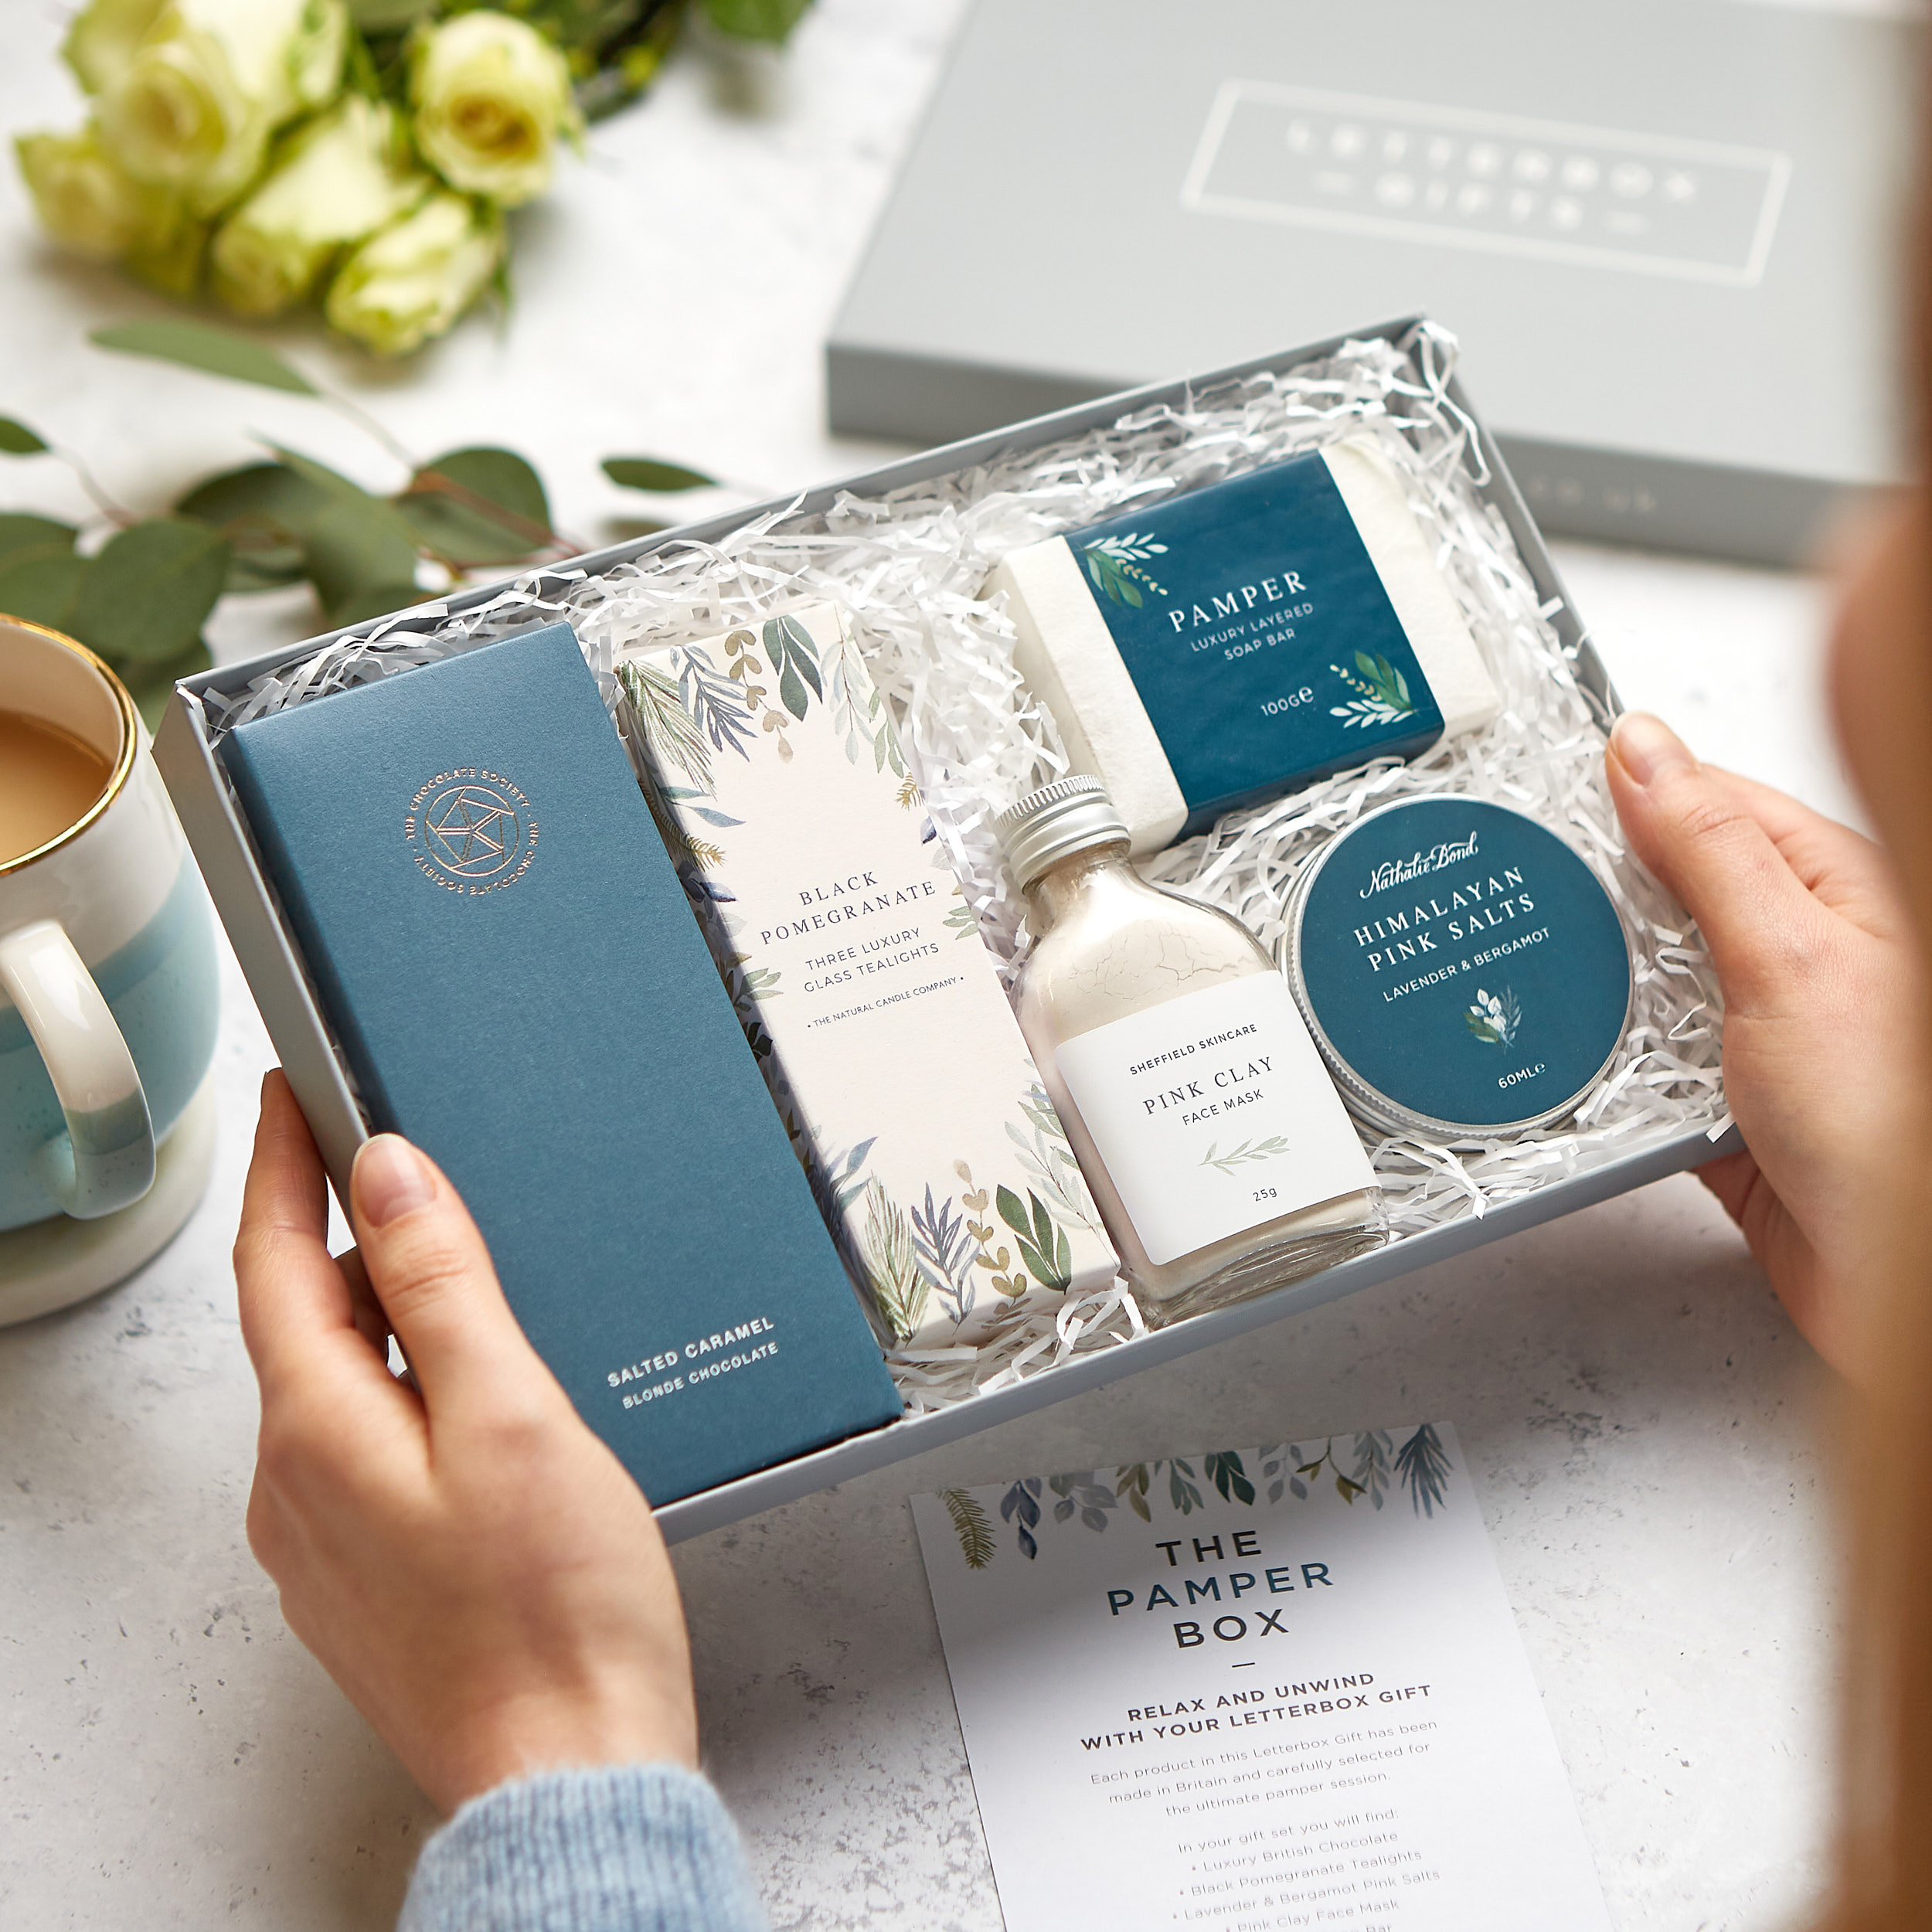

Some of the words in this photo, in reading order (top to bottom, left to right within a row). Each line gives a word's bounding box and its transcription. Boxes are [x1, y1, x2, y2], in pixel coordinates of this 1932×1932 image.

[1168, 570, 1307, 633] PAMPER
[1190, 626, 1245, 652] LUXURY
[1250, 602, 1314, 632] LAYERED
[1223, 639, 1262, 661] SOAP
[1267, 628, 1295, 647] BAR
[405, 815, 415, 840] THE
[410, 767, 476, 811] CHOCOLATE
[481, 770, 530, 807] SOCIETY
[529, 821, 539, 845] THE
[414, 856, 464, 893] SOCIETY
[469, 851, 535, 896] CHOCOLATE
[798, 871, 879, 906] BLACK
[1359, 852, 1430, 899] Nathalie
[1430, 830, 1479, 872] Bond
[760, 881, 937, 945] POMEGRANATE
[1353, 866, 1525, 947] HIMALAYAN
[805, 947, 857, 971] THREE
[862, 927, 920, 954] LUXURY
[1367, 931, 1437, 972] PINK
[1447, 893, 1535, 940] SALTS
[804, 970, 852, 992] GLASS
[856, 943, 940, 975] TEALIGHTS
[1383, 965, 1458, 1002] LAVENDER
[1462, 960, 1471, 971] &
[1474, 927, 1551, 967] BERGAMOT
[813, 1015, 832, 1027] THE
[833, 1003, 875, 1022] NATURAL
[876, 991, 912, 1007] CANDLE
[913, 977, 957, 996] COMPANY
[1130, 1045, 1196, 1075] SHEFFIELD
[1199, 1024, 1257, 1049] SKINCARE
[1142, 1081, 1205, 1115] PINK
[1214, 1056, 1273, 1087] CLAY
[1182, 1105, 1219, 1125] FACE
[1224, 1089, 1264, 1111] MASK
[1253, 1188, 1277, 1202] 25g
[607, 1351, 679, 1388] SALTED
[685, 1317, 774, 1359] CARAMEL
[622, 1377, 685, 1410] BLONDE
[689, 1342, 779, 1384] CHOCOLATE
[1155, 1530, 1263, 1567] THE
[1107, 1562, 1334, 1616] PAMPER
[1173, 1608, 1290, 1648] BOX
[1081, 1730, 1145, 1750] WITH
[1154, 1719, 1220, 1740] YOUR
[1230, 1696, 1369, 1728] LETTERBOX
[1379, 1685, 1433, 1704] GIFT
[1128, 1699, 1206, 1722] RELAX
[1216, 1690, 1265, 1709] AND
[1275, 1673, 1376, 1699] UNWIND
[1091, 1770, 1129, 1785] Each
[1134, 1758, 1196, 1780] product
[1201, 1755, 1215, 1767] in
[1220, 1750, 1248, 1764] this
[1253, 1736, 1330, 1758] Letterbox
[1335, 1731, 1363, 1745] Gift
[1368, 1727, 1394, 1739] has
[1400, 1719, 1437, 1735] been
[1108, 1788, 1152, 1804] made
[1158, 1784, 1171, 1796] in
[1176, 1776, 1229, 1792] Britain
[1233, 1770, 1260, 1783] and
[1266, 1757, 1333, 1777] carefully
[1338, 1746, 1403, 1766] selected
[1409, 1741, 1430, 1754] for
[1165, 1804, 1192, 1817] the
[1196, 1791, 1260, 1811] ultimate
[1266, 1782, 1325, 1801] pamper
[1331, 1771, 1391, 1789] session.
[1178, 1842, 1192, 1854] In
[1198, 1836, 1232, 1852] your
[1238, 1831, 1266, 1845] gift
[1271, 1826, 1294, 1838] set
[1300, 1821, 1328, 1835] you
[1334, 1815, 1360, 1827] will
[1365, 1808, 1399, 1823] find:
[1203, 1855, 1257, 1872] Luxury
[1263, 1845, 1314, 1862] British
[1318, 1832, 1399, 1853] Chocolate
[1184, 1900, 1258, 1920] Lavender
[1264, 1896, 1274, 1907] &
[1280, 1883, 1357, 1904] Bergamot
[1363, 1876, 1397, 1891] Pink
[1402, 1869, 1440, 1885] Salts
[1191, 1880, 1233, 1896] Black
[1240, 1862, 1345, 1889] Pomegranate
[1352, 1849, 1422, 1871] Tealights
[1237, 1920, 1271, 1932] Pink
[1277, 1913, 1311, 1929] Clay
[1316, 1907, 1354, 1922] Face
[1359, 1899, 1400, 1915] Mask
